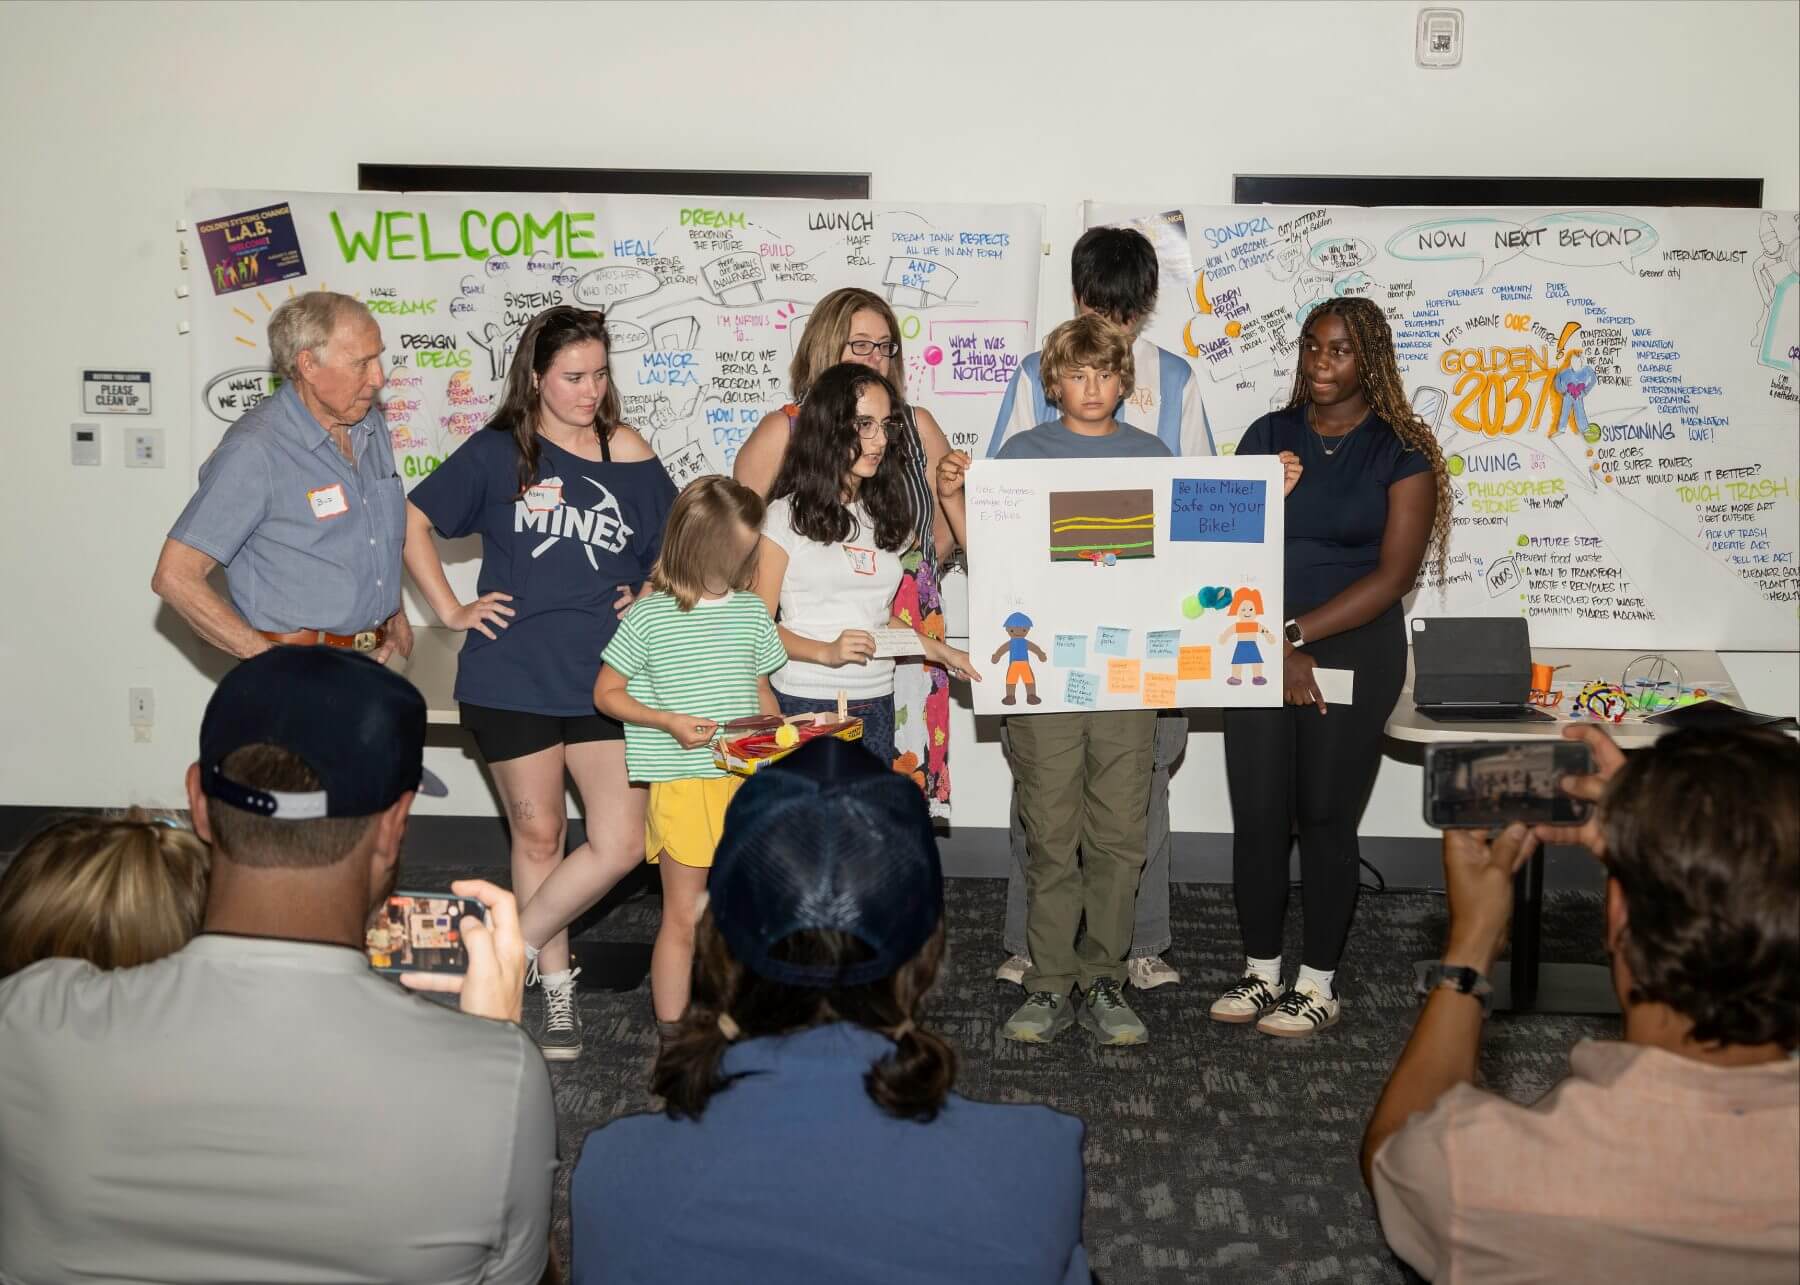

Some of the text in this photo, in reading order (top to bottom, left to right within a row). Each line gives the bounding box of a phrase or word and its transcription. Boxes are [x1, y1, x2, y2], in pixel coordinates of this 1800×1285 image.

[680, 208, 746, 229] DREAM
[808, 210, 874, 231] LAUNCH
[225, 221, 272, 243] L.A.B.
[329, 209, 604, 262] WELCOME
[892, 232, 925, 242] DREAM
[960, 232, 1010, 246] RESPECTS
[1205, 217, 1273, 248] SONDRA
[1419, 228, 1642, 249] NOW NEXT BEYOND
[694, 240, 743, 250] THE FUTURE
[846, 235, 869, 245] MAKE
[613, 239, 657, 257] HEAL
[760, 244, 795, 257] BUILD
[855, 247, 863, 256] IT
[906, 247, 1003, 259] ALL LIFE IN ANY FORM
[847, 255, 875, 266] REAL
[1206, 256, 1223, 270] HOW
[1663, 250, 1748, 264] INTERNATIONALIST
[785, 262, 808, 271] NEED
[908, 260, 936, 273] AND
[367, 299, 437, 314] DREAMS
[504, 290, 563, 308] SYSTEMS
[1224, 303, 1252, 320] THEM
[1442, 312, 1559, 347] LET'S IMAGINE OUR FUTURE
[400, 334, 456, 350] DESIGN
[949, 332, 1006, 349] what was
[416, 350, 472, 369] IDEAS
[643, 353, 699, 368] MAYOR
[716, 350, 777, 361] HOW DO WE
[952, 350, 1018, 371] 1 thing you
[1206, 347, 1234, 365] THEM
[1440, 345, 1549, 375] GOLDEN
[722, 364, 771, 375] BRING A
[228, 377, 263, 392] WHAT
[637, 370, 699, 386] LAURA
[712, 377, 781, 390] PROGRAM TO
[101, 384, 134, 395] PLEASE
[96, 395, 139, 406] CLEAN UP
[218, 394, 237, 409] WE
[1452, 368, 1558, 438] 2037
[706, 409, 758, 425] HOW DO
[1681, 416, 1729, 425] IMAGINATION
[1602, 422, 1676, 442] SUSTAINING
[1598, 447, 1644, 459] OUR JOBS
[1468, 453, 1521, 472] LIVING
[1602, 457, 1693, 472] OUR SUPER POWERS
[1616, 463, 1762, 485] WHAT WOULD MAKE IT BETTER?
[1178, 480, 1254, 495] Be like Mike!
[1468, 478, 1567, 498] PHILOSOPHER
[1727, 477, 1789, 501] TRASH
[1172, 499, 1203, 513] Safe
[1209, 503, 1224, 513] on
[1471, 499, 1521, 513] STONE
[1706, 501, 1776, 512] MAKE MORE ART
[1199, 518, 1235, 533] Bike!
[1472, 517, 1509, 526] SECURITY
[1705, 514, 1756, 523] GET OUTSIDE
[514, 500, 634, 554] MINES
[1739, 528, 1767, 538] TRASH
[1531, 536, 1570, 547] FUTURE
[1712, 541, 1771, 551] CREATE ART
[1551, 552, 1571, 565] food
[1575, 553, 1602, 562] waste
[1773, 552, 1792, 563] ART
[1571, 567, 1622, 577] TRANSFORM
[1592, 597, 1613, 606] FOOD
[1616, 597, 1645, 607] WASTE
[1529, 607, 1573, 617] COMMUNITY
